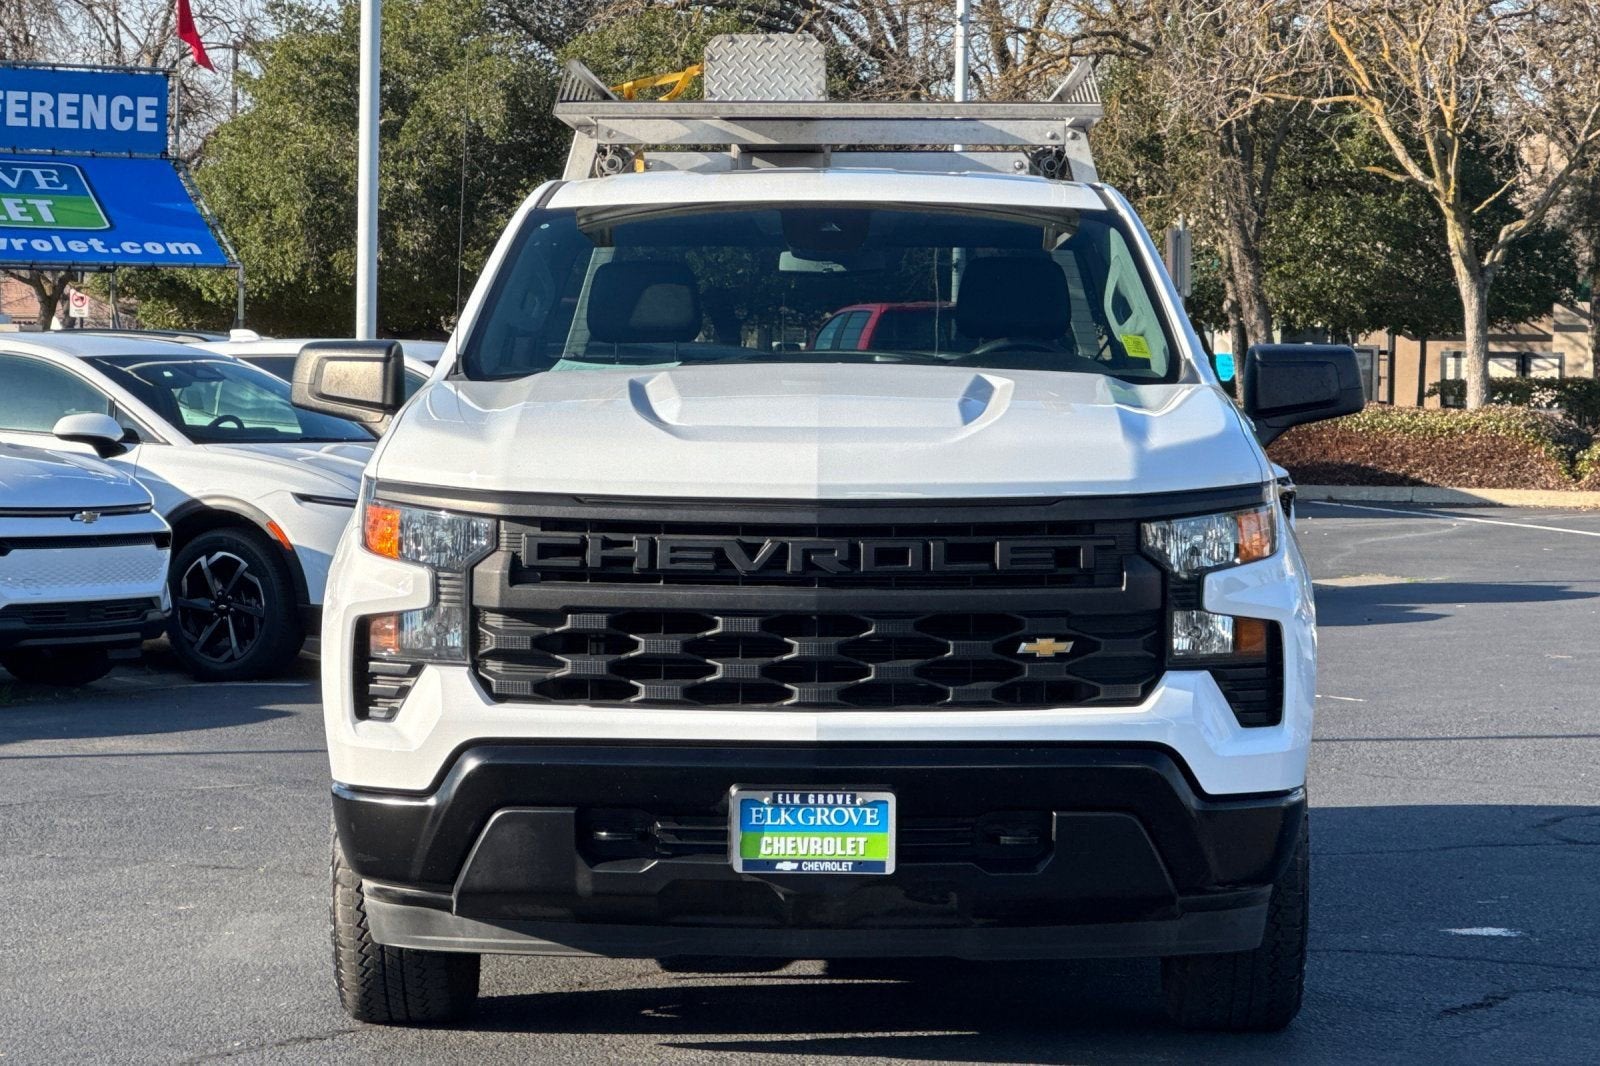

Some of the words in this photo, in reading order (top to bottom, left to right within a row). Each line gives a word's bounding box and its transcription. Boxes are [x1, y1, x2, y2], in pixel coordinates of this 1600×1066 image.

[0, 90, 158, 132] ERENCE
[520, 532, 1117, 575] CHEVROLET
[777, 793, 801, 805] ELK
[808, 794, 852, 805] GROVE
[750, 807, 797, 826] ELK
[797, 807, 880, 827] GROVE
[760, 836, 868, 857] CHEVROLET
[801, 861, 854, 872] CHEVROLET
